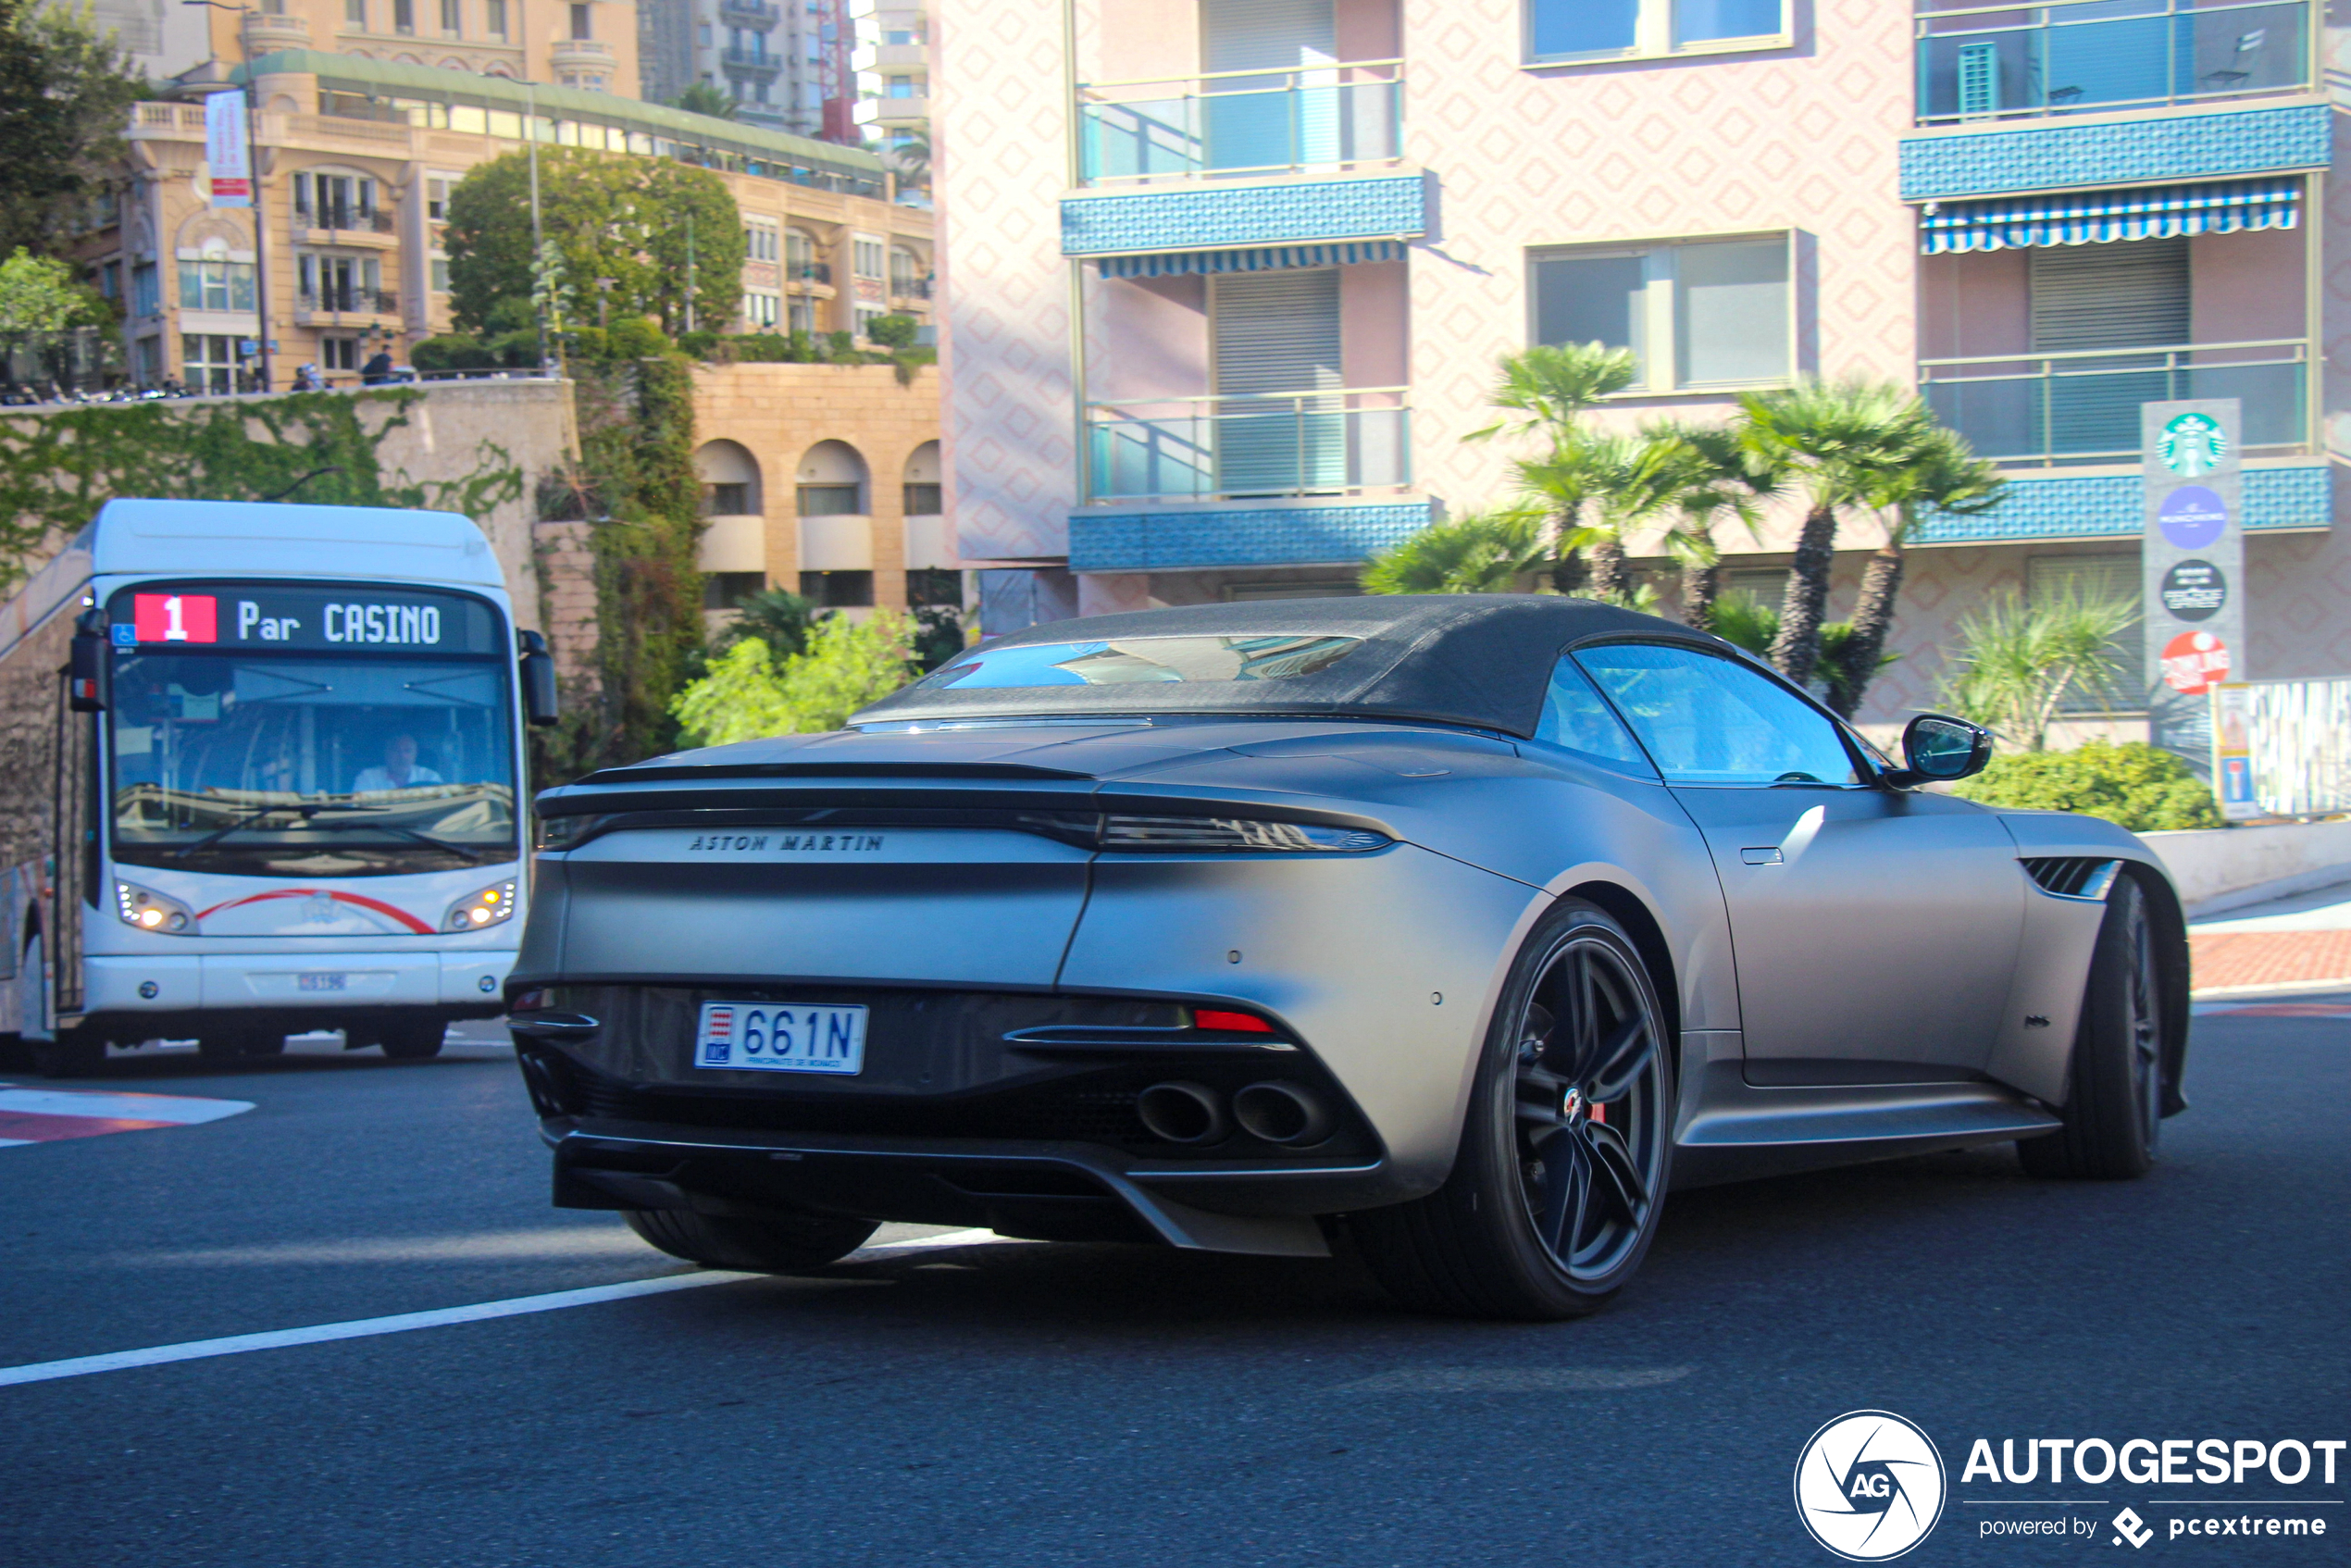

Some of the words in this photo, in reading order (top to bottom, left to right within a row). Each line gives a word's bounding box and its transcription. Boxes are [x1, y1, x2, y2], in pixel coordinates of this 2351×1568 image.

[164, 596, 188, 641] 1
[238, 601, 301, 641] Par
[324, 604, 440, 644] CASINO
[690, 835, 768, 851] ASTON
[779, 835, 884, 851] MARTIN
[744, 1010, 853, 1057] 661N
